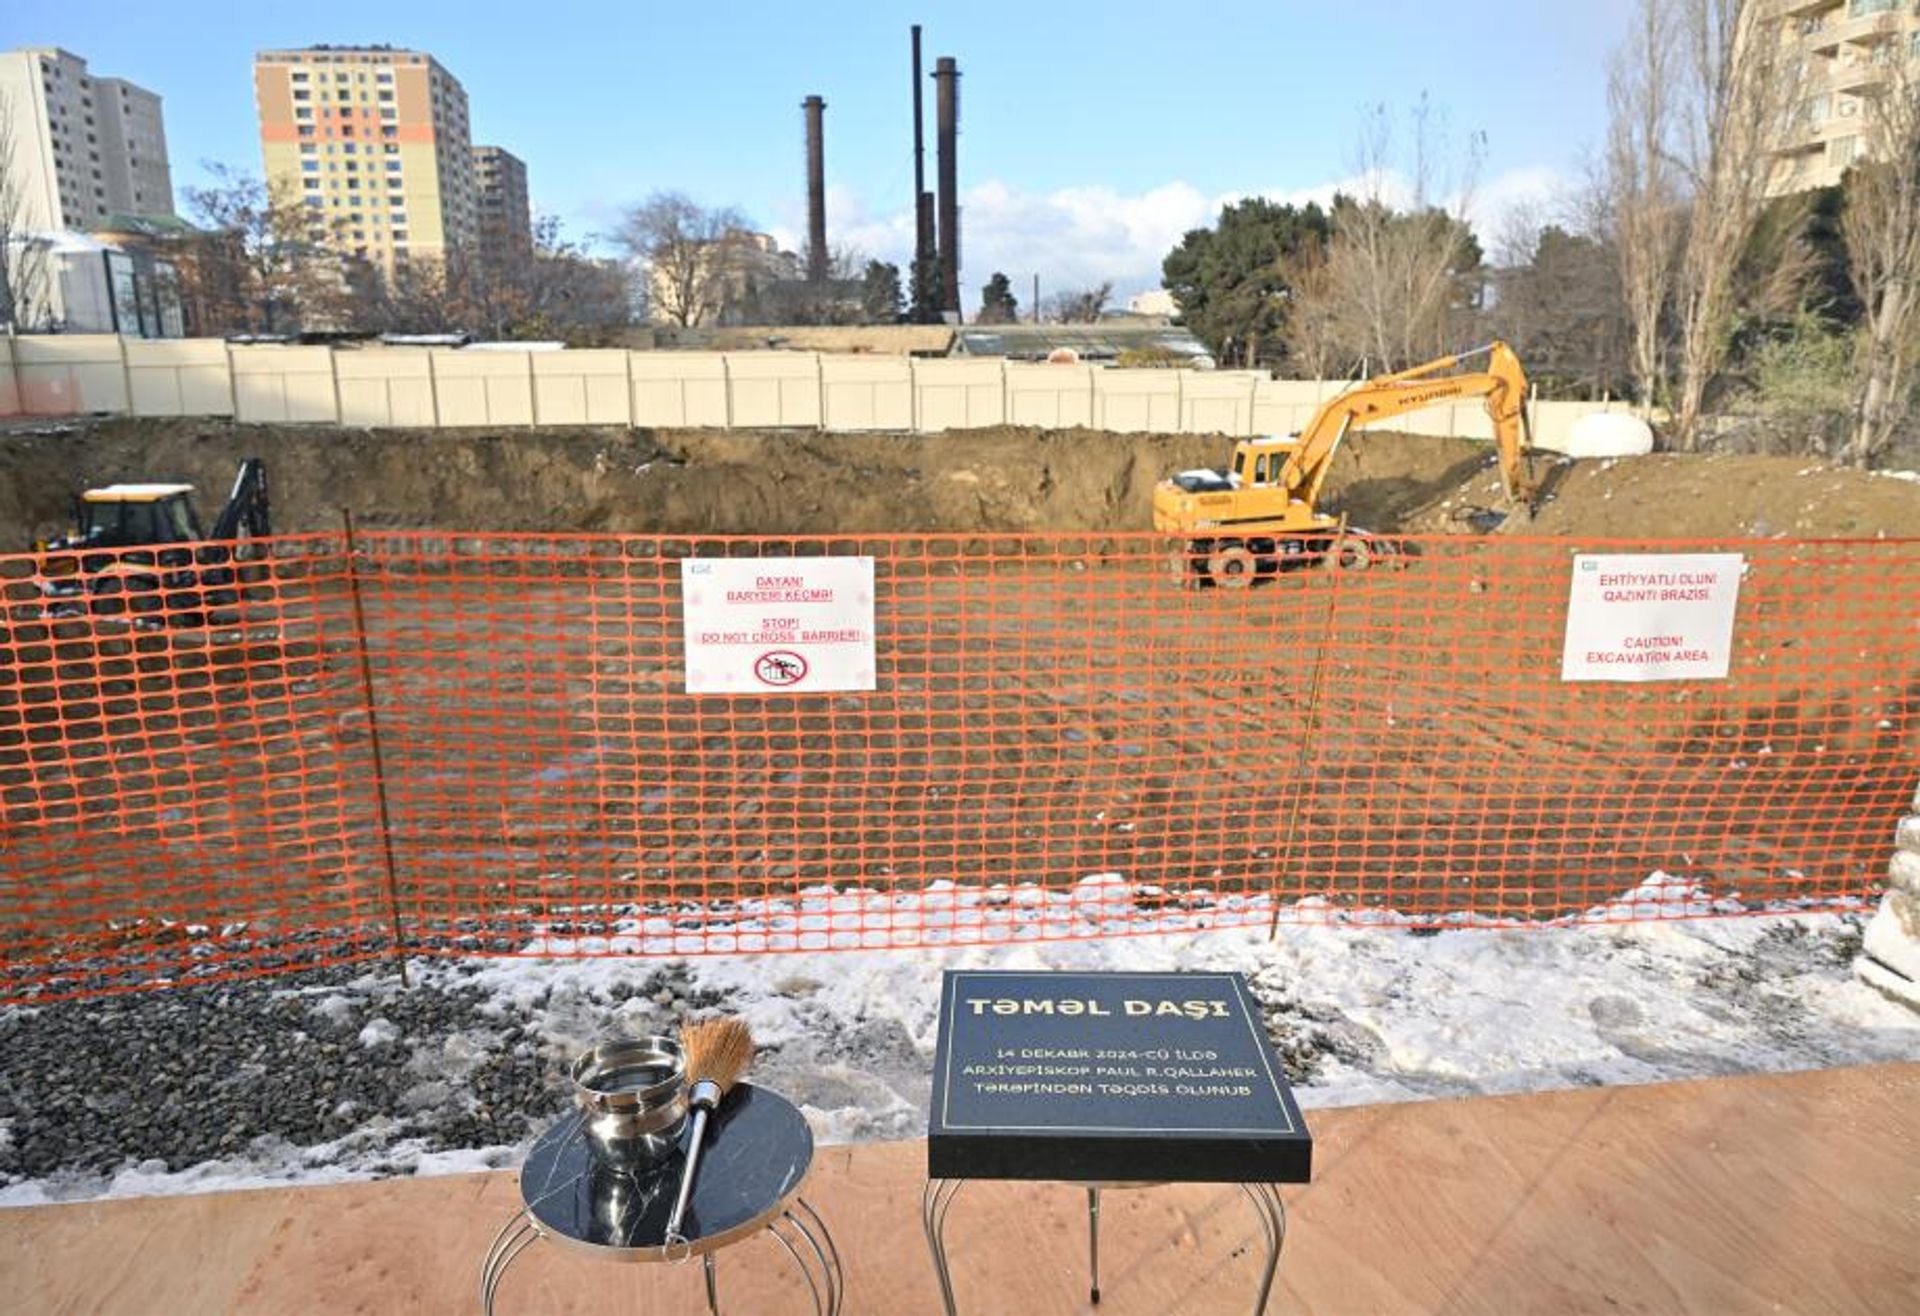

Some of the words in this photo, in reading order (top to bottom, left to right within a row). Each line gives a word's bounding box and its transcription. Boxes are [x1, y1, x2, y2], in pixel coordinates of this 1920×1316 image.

[762, 618, 799, 629] STOP!
[702, 633, 720, 643] DO
[723, 632, 748, 643] NOT
[752, 631, 795, 642] CROSS
[802, 629, 860, 641] BARRIER!
[1624, 636, 1683, 648] CAUTION!
[1586, 651, 1670, 663] EXCAVATION
[1674, 650, 1708, 662] AREA
[966, 999, 1110, 1016] TƏMƏL
[1124, 1000, 1230, 1020] DAŞI
[997, 1048, 1015, 1058] 14
[1021, 1048, 1090, 1058] DEKABR
[1096, 1067, 1141, 1076] PAUL
[1175, 1085, 1252, 1096] OLUNUB
